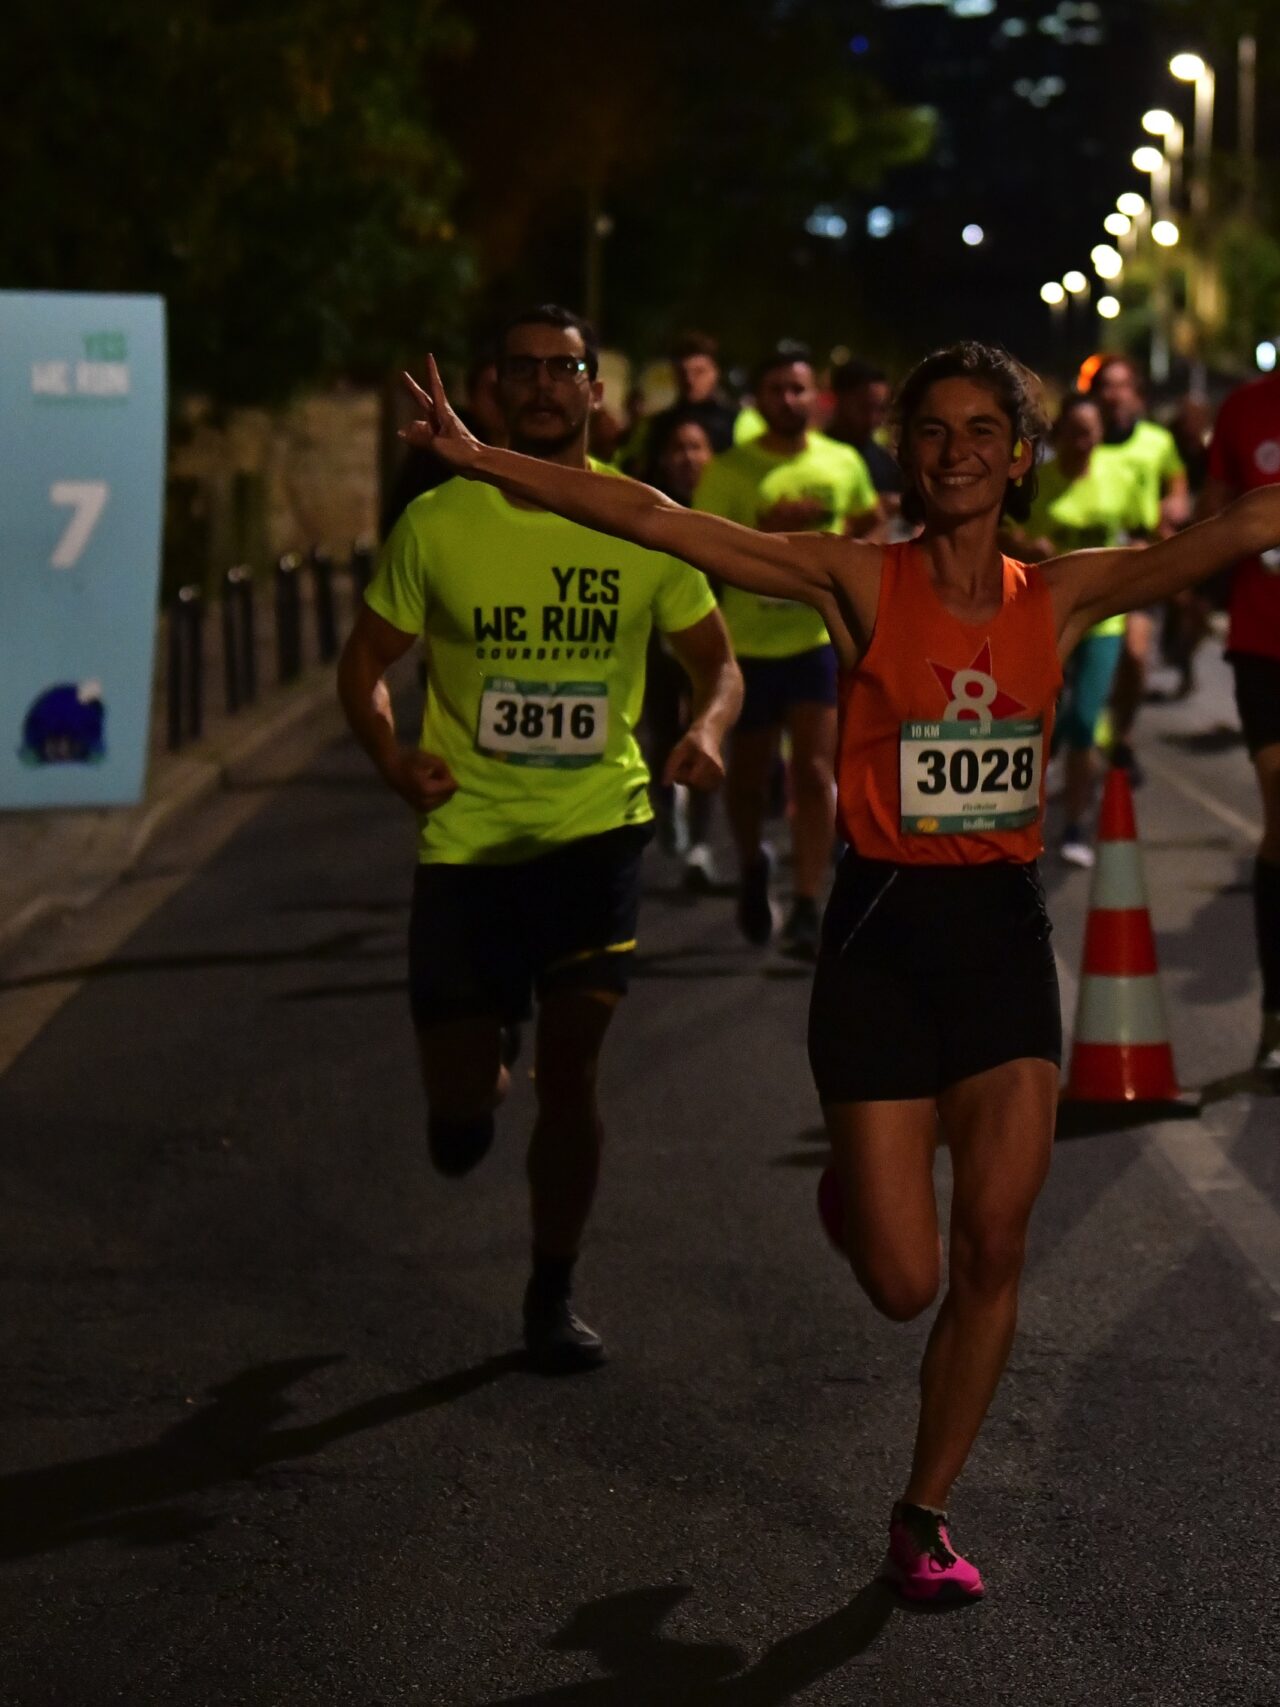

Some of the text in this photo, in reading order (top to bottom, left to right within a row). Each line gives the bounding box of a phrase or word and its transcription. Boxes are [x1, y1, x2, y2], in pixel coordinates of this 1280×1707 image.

[49, 479, 109, 570] 7
[551, 566, 620, 605] YES
[474, 606, 618, 643] WE RUN
[943, 669, 998, 721] 8
[493, 700, 595, 739] 3816
[917, 747, 1034, 795] 3028
